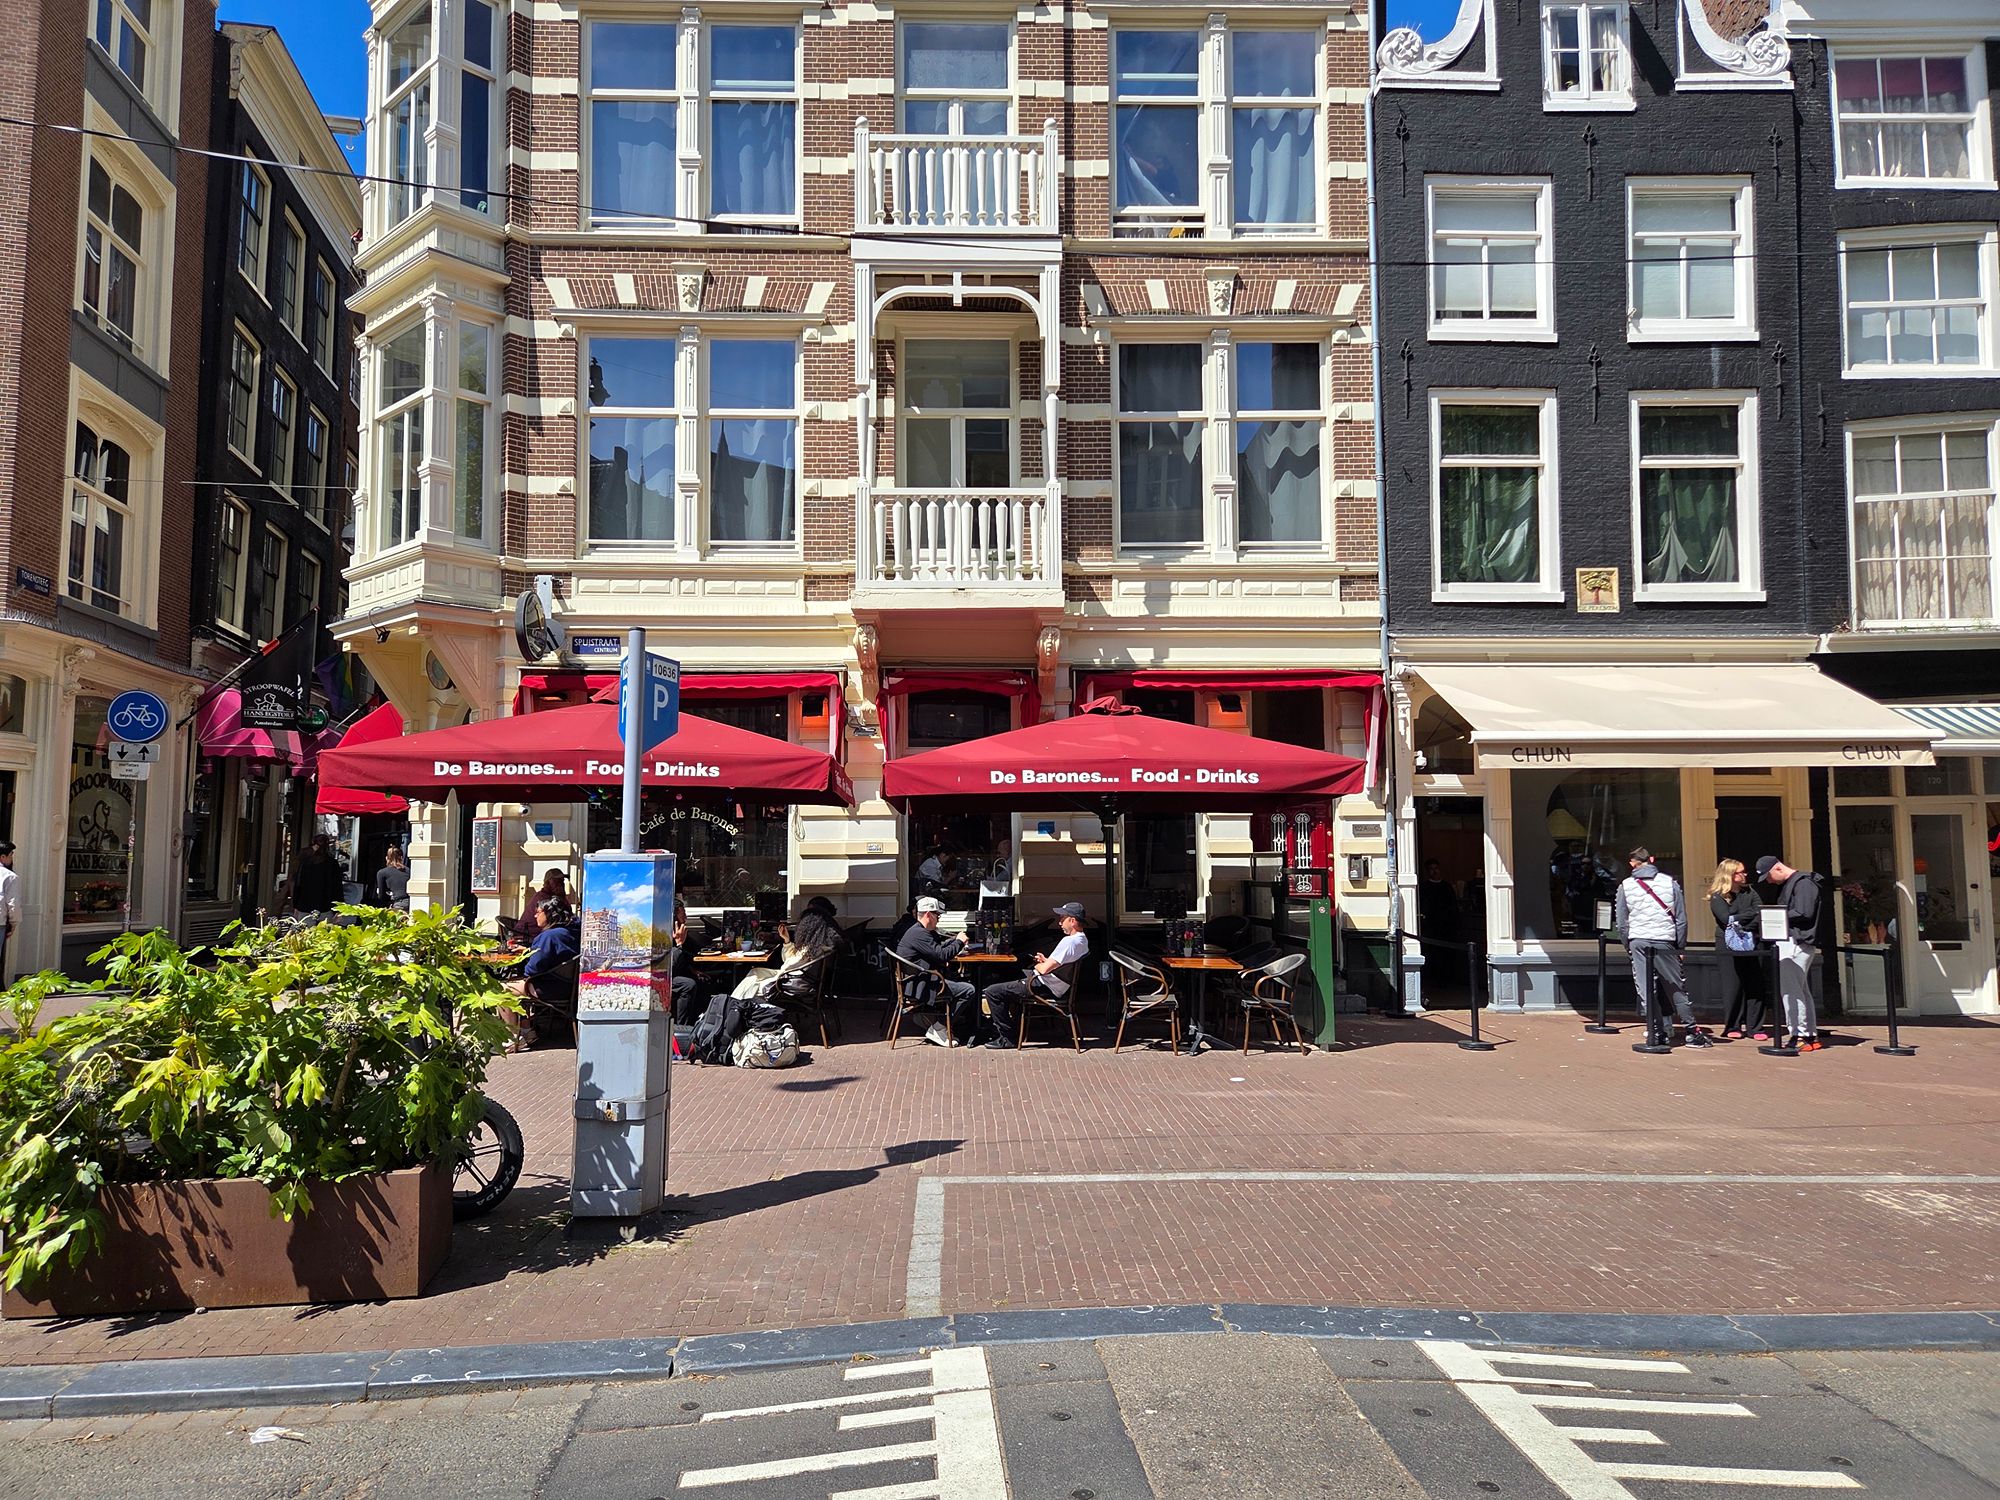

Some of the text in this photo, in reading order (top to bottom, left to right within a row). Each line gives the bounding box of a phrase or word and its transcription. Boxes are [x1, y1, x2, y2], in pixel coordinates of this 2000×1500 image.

[653, 663, 677, 680] 10636
[243, 683, 296, 698] STROOPWAFEL
[653, 683, 670, 721] P
[1511, 747, 1572, 762] CHUN
[1842, 745, 1901, 760] CHUN
[434, 761, 462, 776] De
[468, 761, 573, 776] Barones...
[586, 760, 626, 775] Foo
[655, 761, 720, 777] Drinks
[990, 770, 1016, 784] De
[1022, 769, 1119, 783] Barones...
[1131, 768, 1179, 783] Food
[1196, 769, 1259, 784] Drinks
[639, 813, 666, 836] Café
[670, 808, 686, 820] de
[690, 806, 739, 836] Barones
[476, 1165, 516, 1206] KENDA
